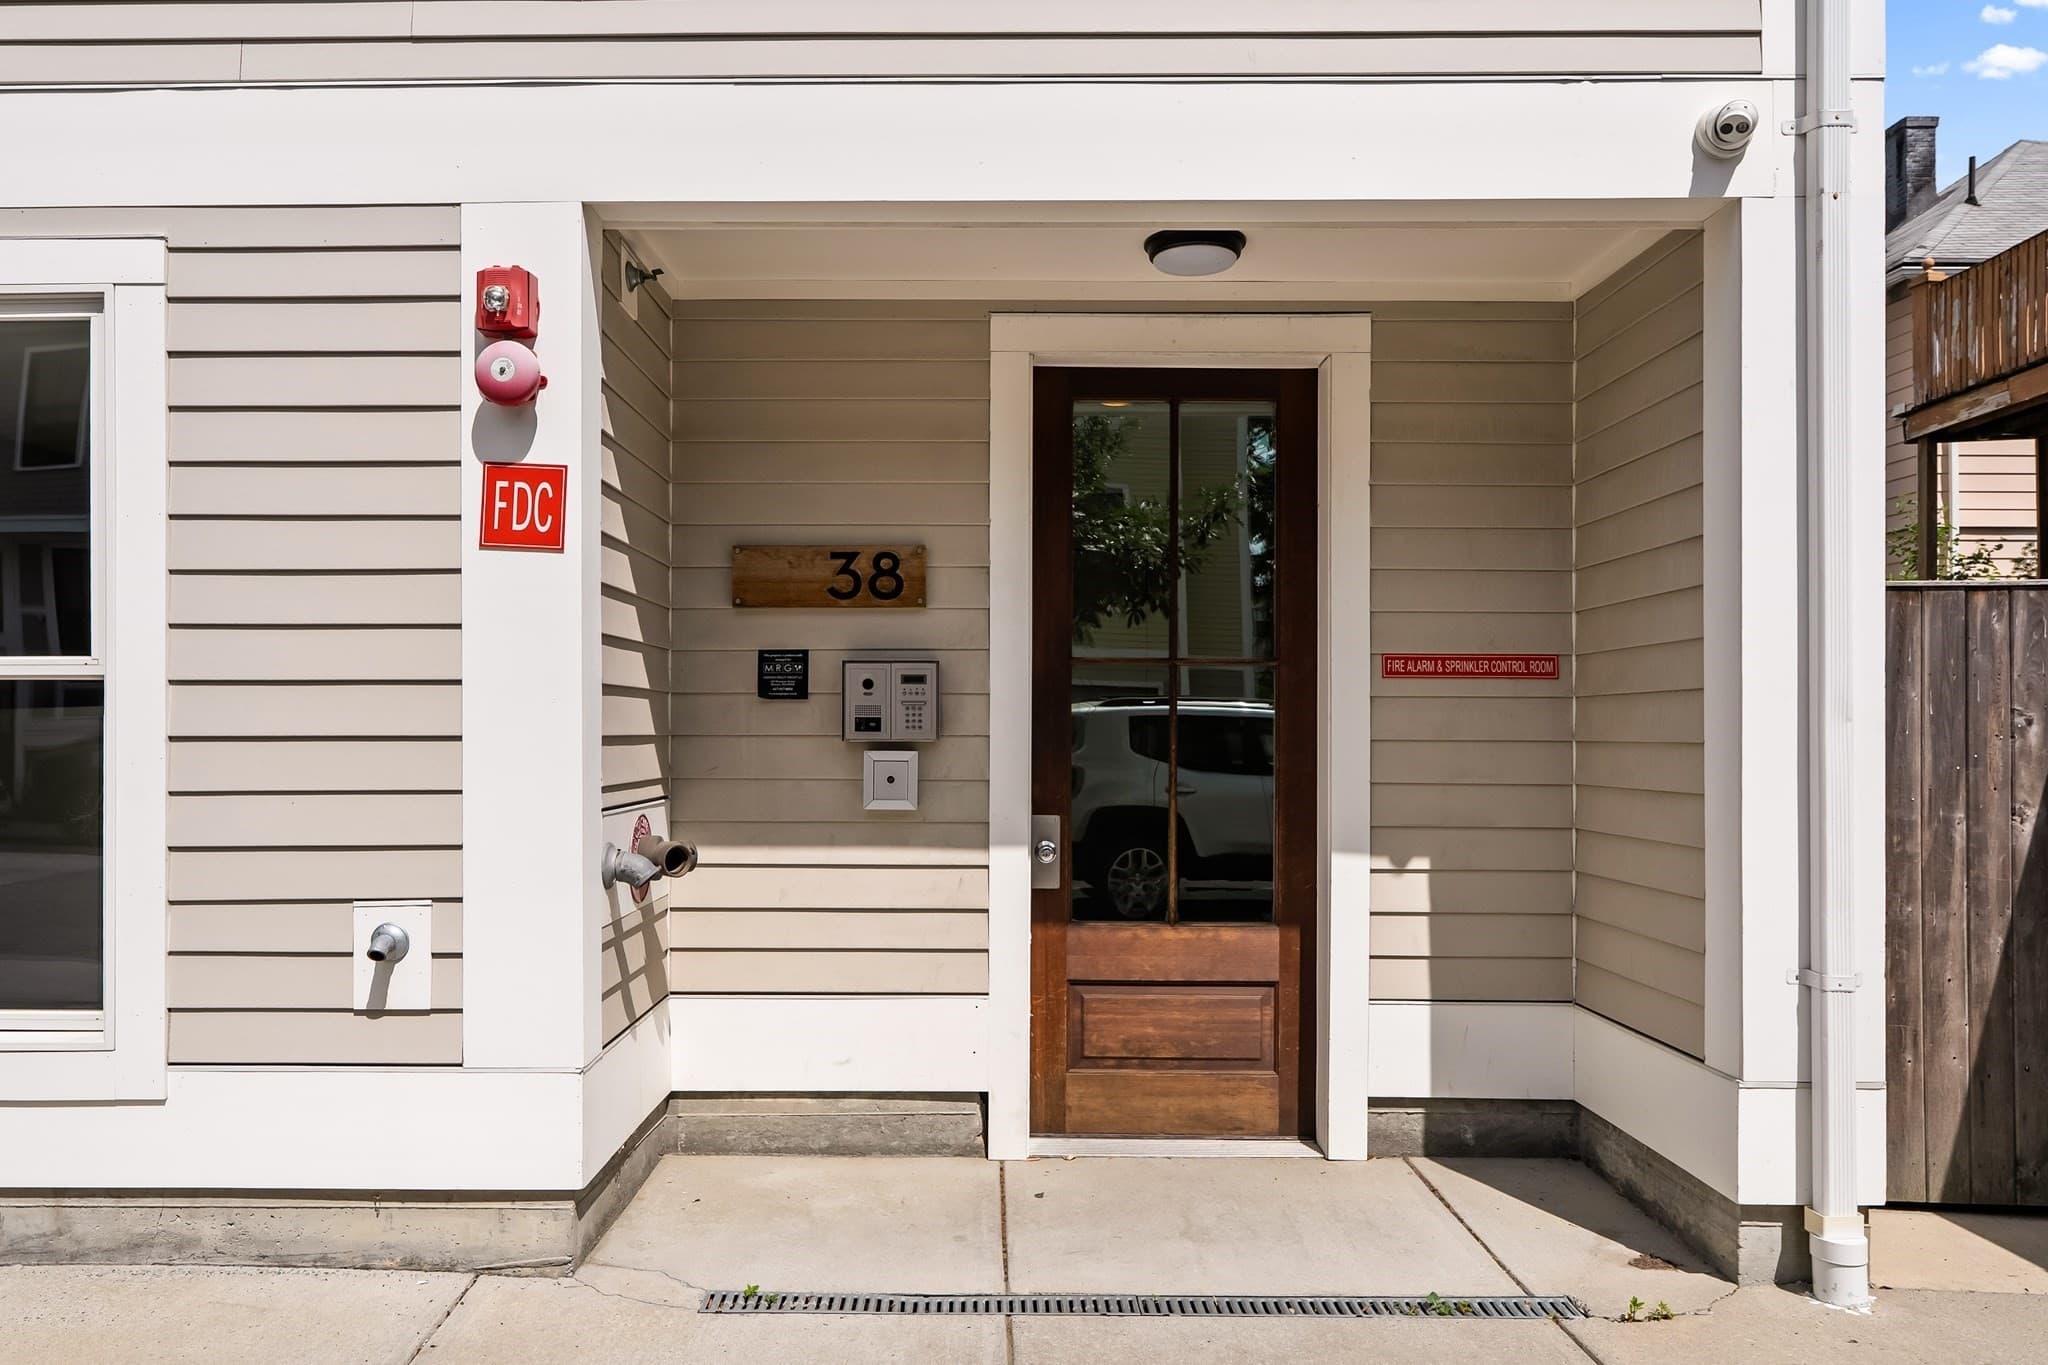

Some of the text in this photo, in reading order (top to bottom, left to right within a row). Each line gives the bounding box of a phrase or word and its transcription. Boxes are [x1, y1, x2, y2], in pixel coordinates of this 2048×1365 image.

[493, 480, 553, 533] FDC
[826, 551, 904, 601] 38
[1387, 659, 1554, 673] FIRE ALARM & SPRINKLER CONTROL ROOM
